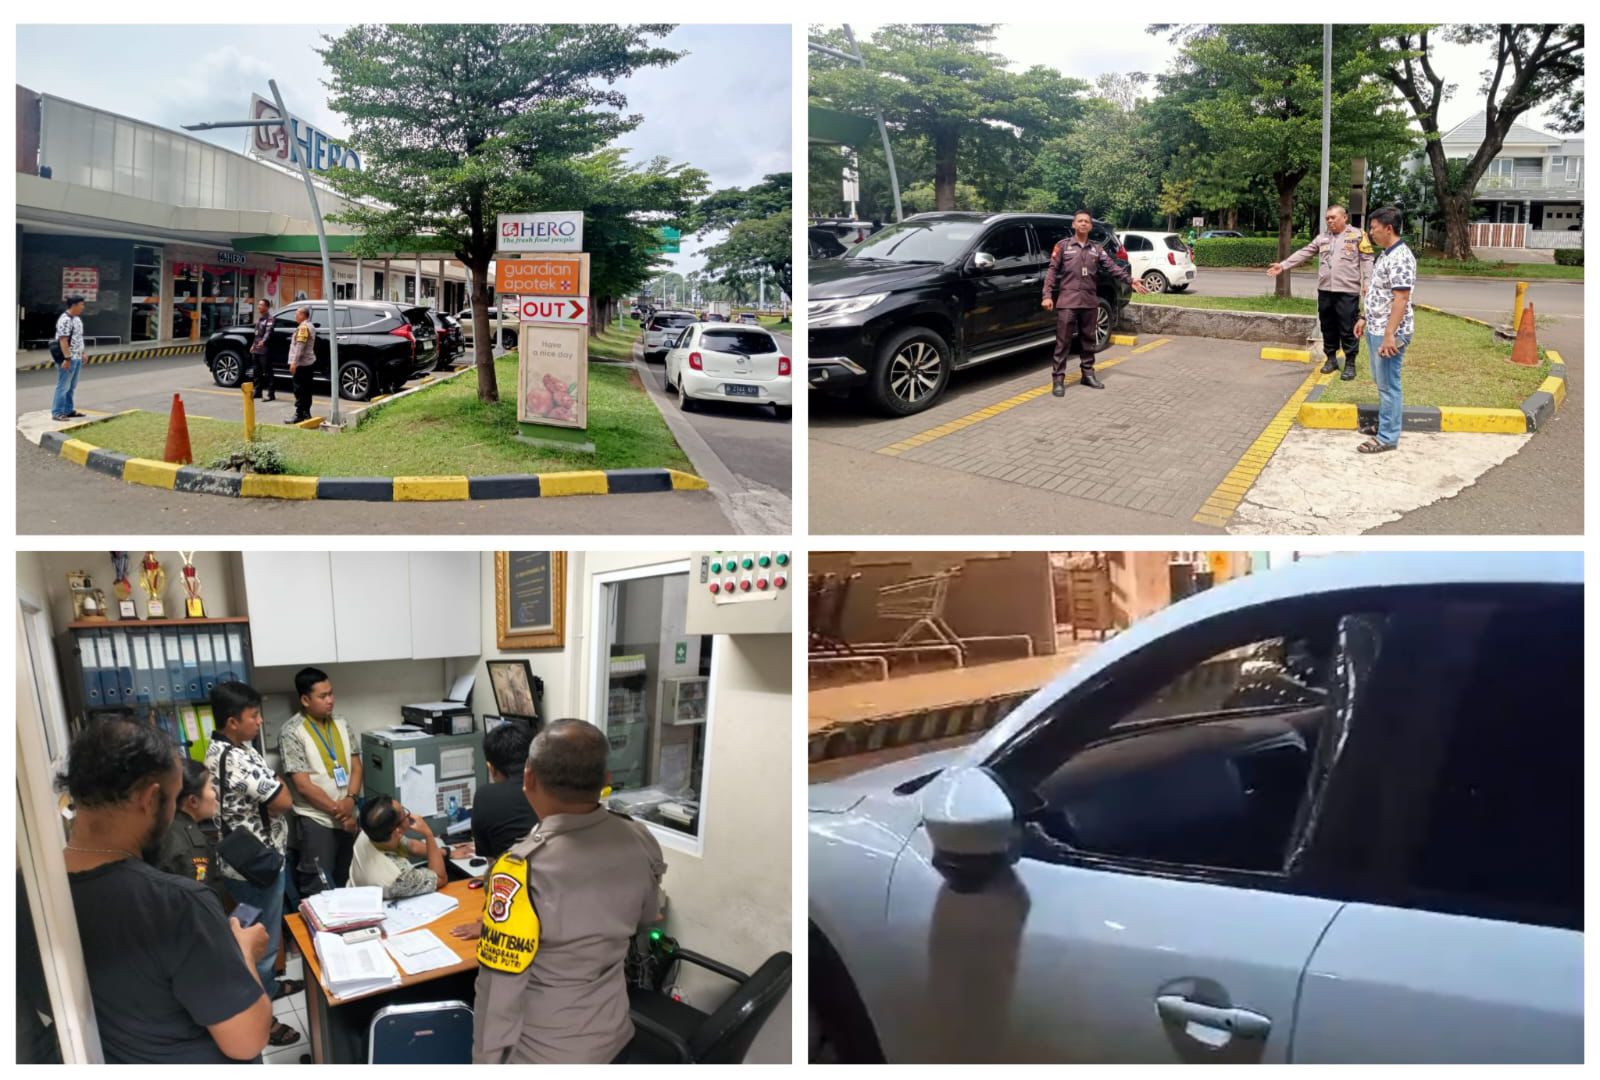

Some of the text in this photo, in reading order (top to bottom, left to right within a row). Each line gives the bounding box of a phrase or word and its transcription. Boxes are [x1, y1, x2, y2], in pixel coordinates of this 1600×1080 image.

[290, 117, 361, 171] HERO
[520, 221, 576, 236] HERO
[534, 236, 550, 245] food
[551, 236, 575, 245] people
[504, 262, 572, 277] guardian
[504, 278, 556, 292] apotek
[523, 302, 565, 318] OUT
[542, 340, 562, 349] Have
[539, 350, 556, 358] nice
[557, 351, 573, 360] day
